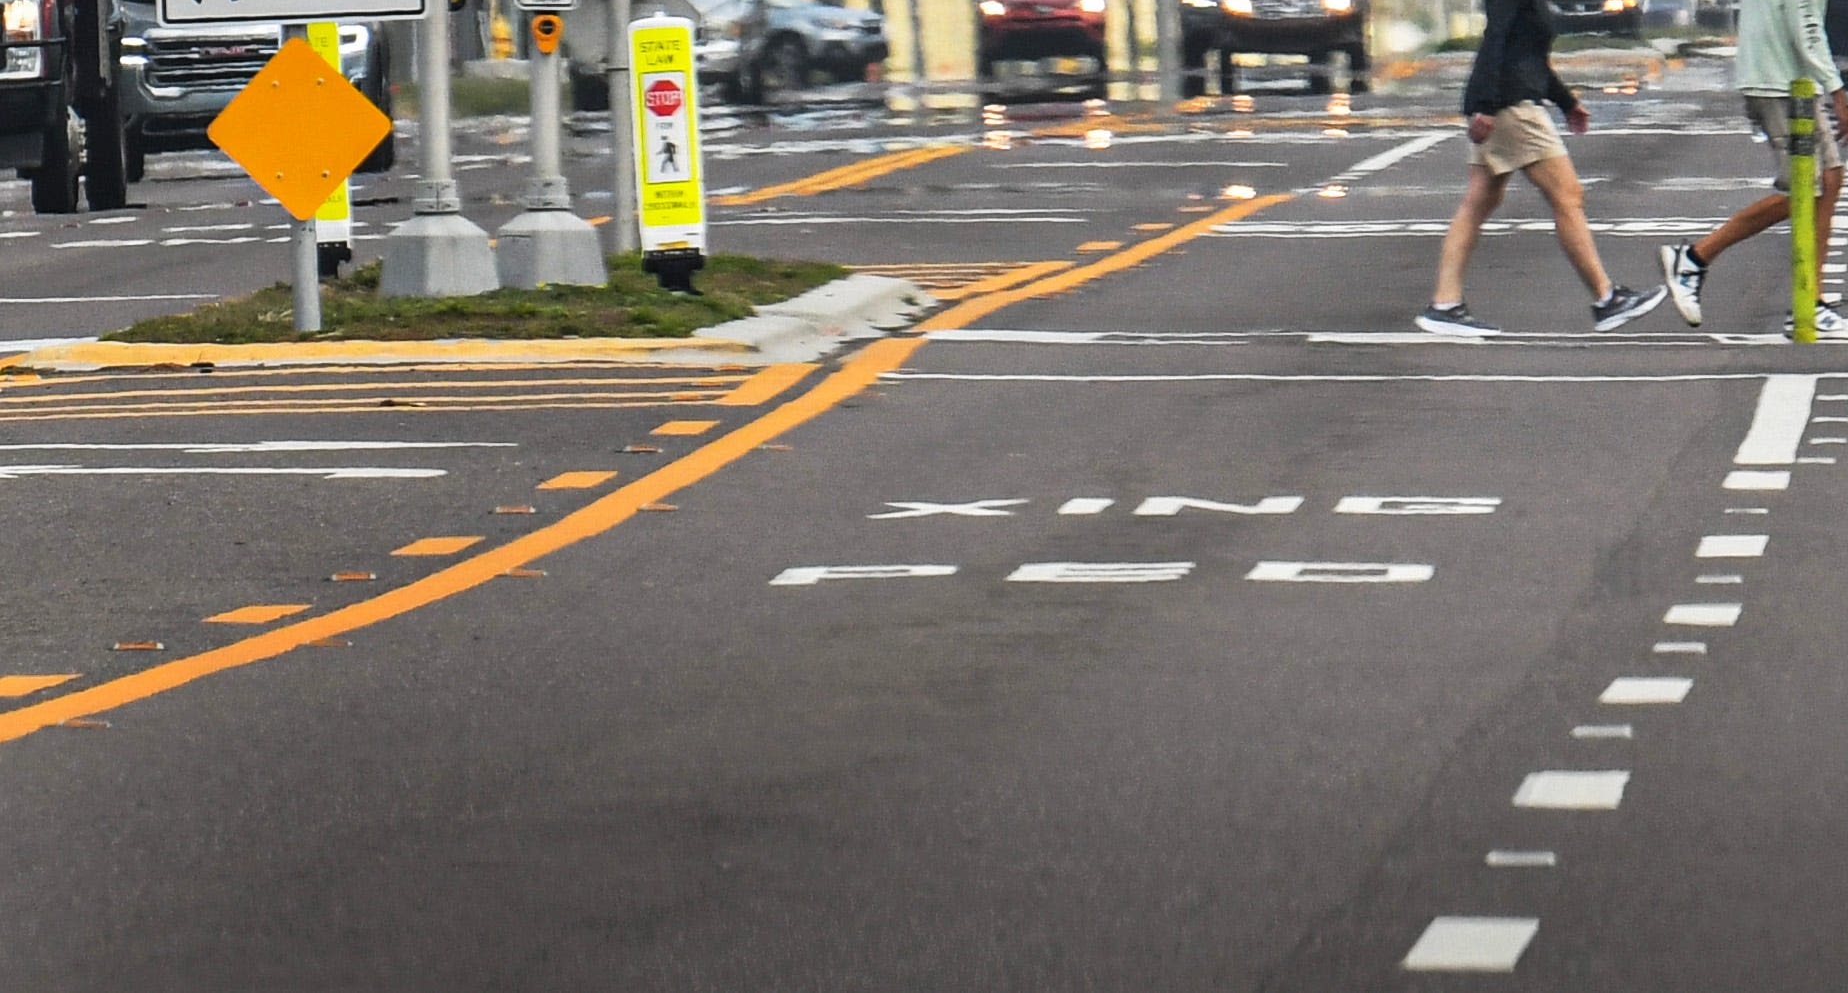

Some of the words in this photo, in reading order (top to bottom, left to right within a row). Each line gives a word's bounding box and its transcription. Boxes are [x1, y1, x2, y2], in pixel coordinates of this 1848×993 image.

[639, 39, 681, 54] STATE
[646, 53, 674, 66] LAW
[646, 90, 682, 107] STOP
[866, 496, 1501, 518] XING
[768, 561, 1436, 585] PED
